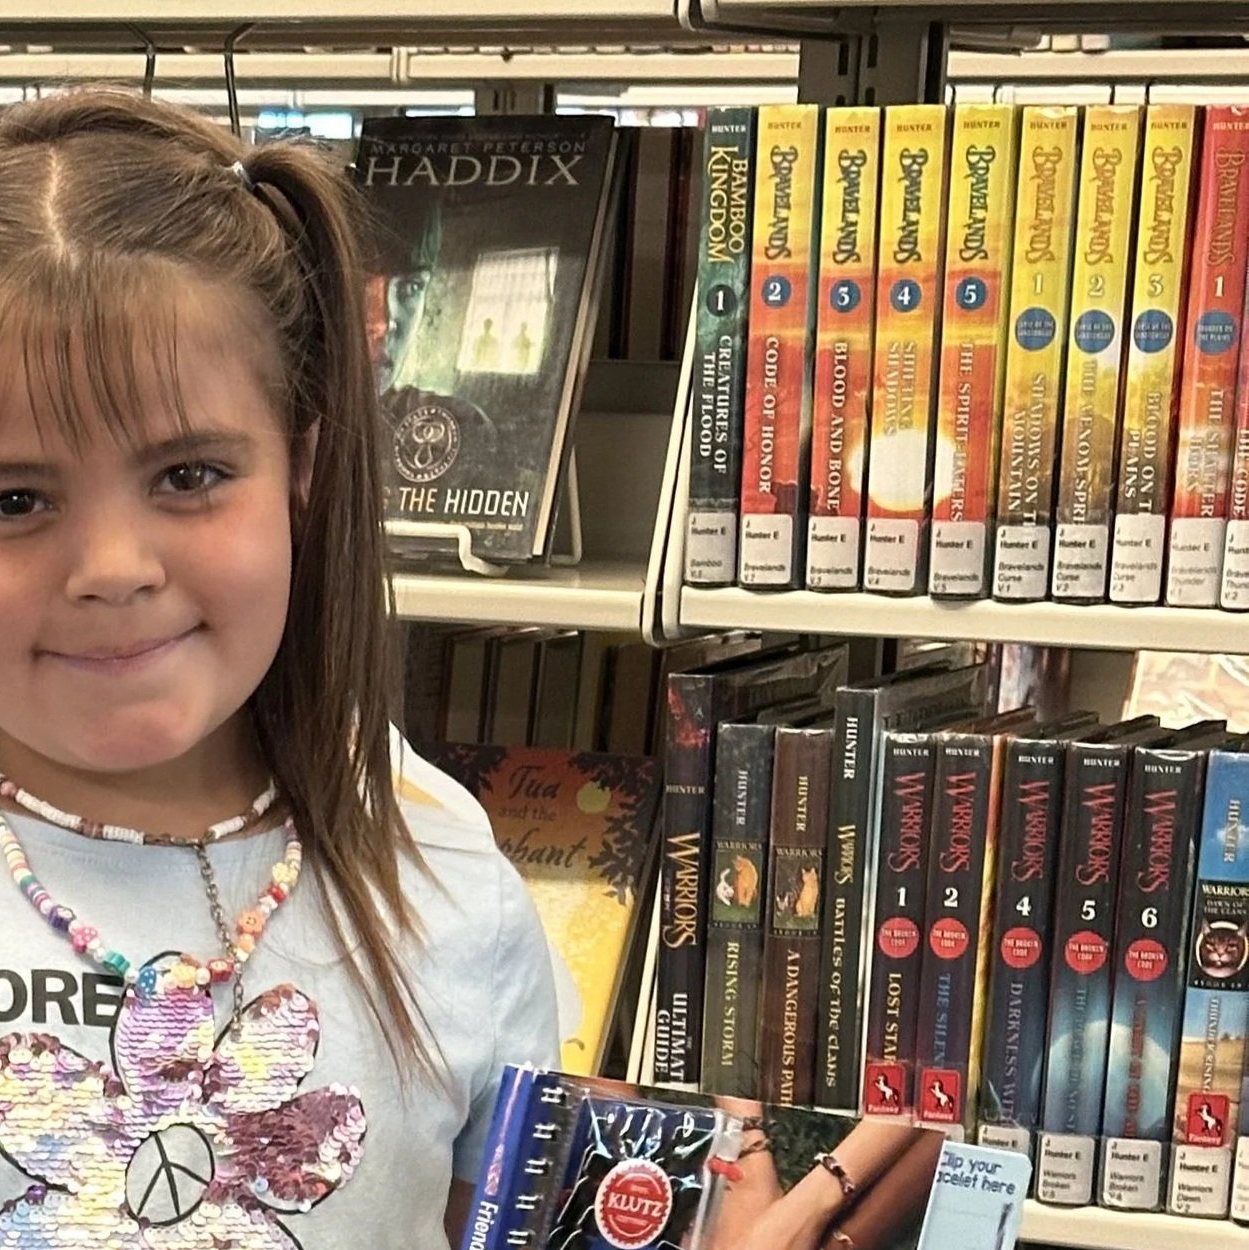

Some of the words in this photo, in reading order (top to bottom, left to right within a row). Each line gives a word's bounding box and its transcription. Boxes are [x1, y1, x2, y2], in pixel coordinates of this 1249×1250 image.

[711, 124, 747, 133] HUNTER
[767, 121, 802, 130] HUNTER
[835, 125, 870, 134] HUNTER
[896, 124, 932, 133] HUNTER
[963, 121, 1000, 129] HUNTER
[1029, 121, 1067, 130] HUNTER
[1091, 123, 1127, 131] HUNTER
[1150, 121, 1187, 130] HUNTER
[482, 141, 586, 153] PETERSON
[365, 155, 583, 187] HADDIX
[707, 146, 739, 264] KINGDOM
[728, 159, 749, 253] BAMBOO
[764, 145, 799, 261] BRAVELANDS
[832, 148, 867, 265] BRAVELANDS
[893, 148, 929, 265] BRAVELANDS
[959, 144, 997, 262] BRAVELANDS
[1025, 145, 1063, 264] BRAVELANDS
[1085, 147, 1123, 266] BRAVELANDS
[1143, 146, 1183, 266] BRAVELANDS
[964, 285, 977, 304] 5
[702, 352, 716, 387] THE
[764, 336, 780, 389] CODE
[831, 342, 848, 408] BLOOD
[960, 343, 974, 375] THE
[714, 335, 733, 443] CREATURES
[763, 394, 777, 419] OF
[700, 393, 714, 457] FLOOD
[1208, 391, 1223, 426] THE
[830, 416, 845, 452] AND
[713, 449, 728, 474] OF
[758, 425, 775, 494] HONOR
[826, 458, 843, 510] BONE
[1025, 478, 1039, 506] ON
[1140, 465, 1155, 491] ON
[399, 487, 438, 513] THE
[444, 488, 529, 517] HIDDEN
[691, 527, 718, 536] Hunter
[843, 717, 858, 780] HUNTER
[893, 748, 929, 757] HUNTER
[945, 748, 980, 757] HUNTER
[1018, 756, 1054, 764] HUNTER
[1084, 758, 1120, 767] HUNTER
[508, 765, 560, 800] Tua
[1144, 765, 1182, 774] HUNTER
[665, 785, 705, 795] HUNTER
[735, 769, 748, 826] HUNTER
[796, 776, 809, 832] HUNTER
[887, 772, 926, 873] WARRIORS
[939, 772, 977, 873] WARRIORS
[1010, 781, 1050, 882] WARRIORS
[1075, 783, 1116, 886] WARRIORS
[1223, 799, 1241, 863] HUNTER
[1137, 791, 1177, 892] WARRIORS
[662, 832, 701, 949] WARRIORS
[943, 887, 958, 908] 2
[1016, 896, 1031, 917] 4
[1081, 900, 1096, 921] 5
[1141, 907, 1158, 928] 6
[724, 941, 740, 1001] RISING
[886, 973, 902, 1017] LOST
[937, 973, 951, 1009] THE
[782, 964, 800, 1067] DANGEROUS
[1004, 983, 1024, 1082] DARKNESS
[654, 1009, 671, 1075] GUIDE
[721, 1005, 736, 1066] STORM
[969, 1158, 1002, 1174] your
[981, 1176, 1016, 1195] here
[607, 1192, 663, 1217] KLUTZ
